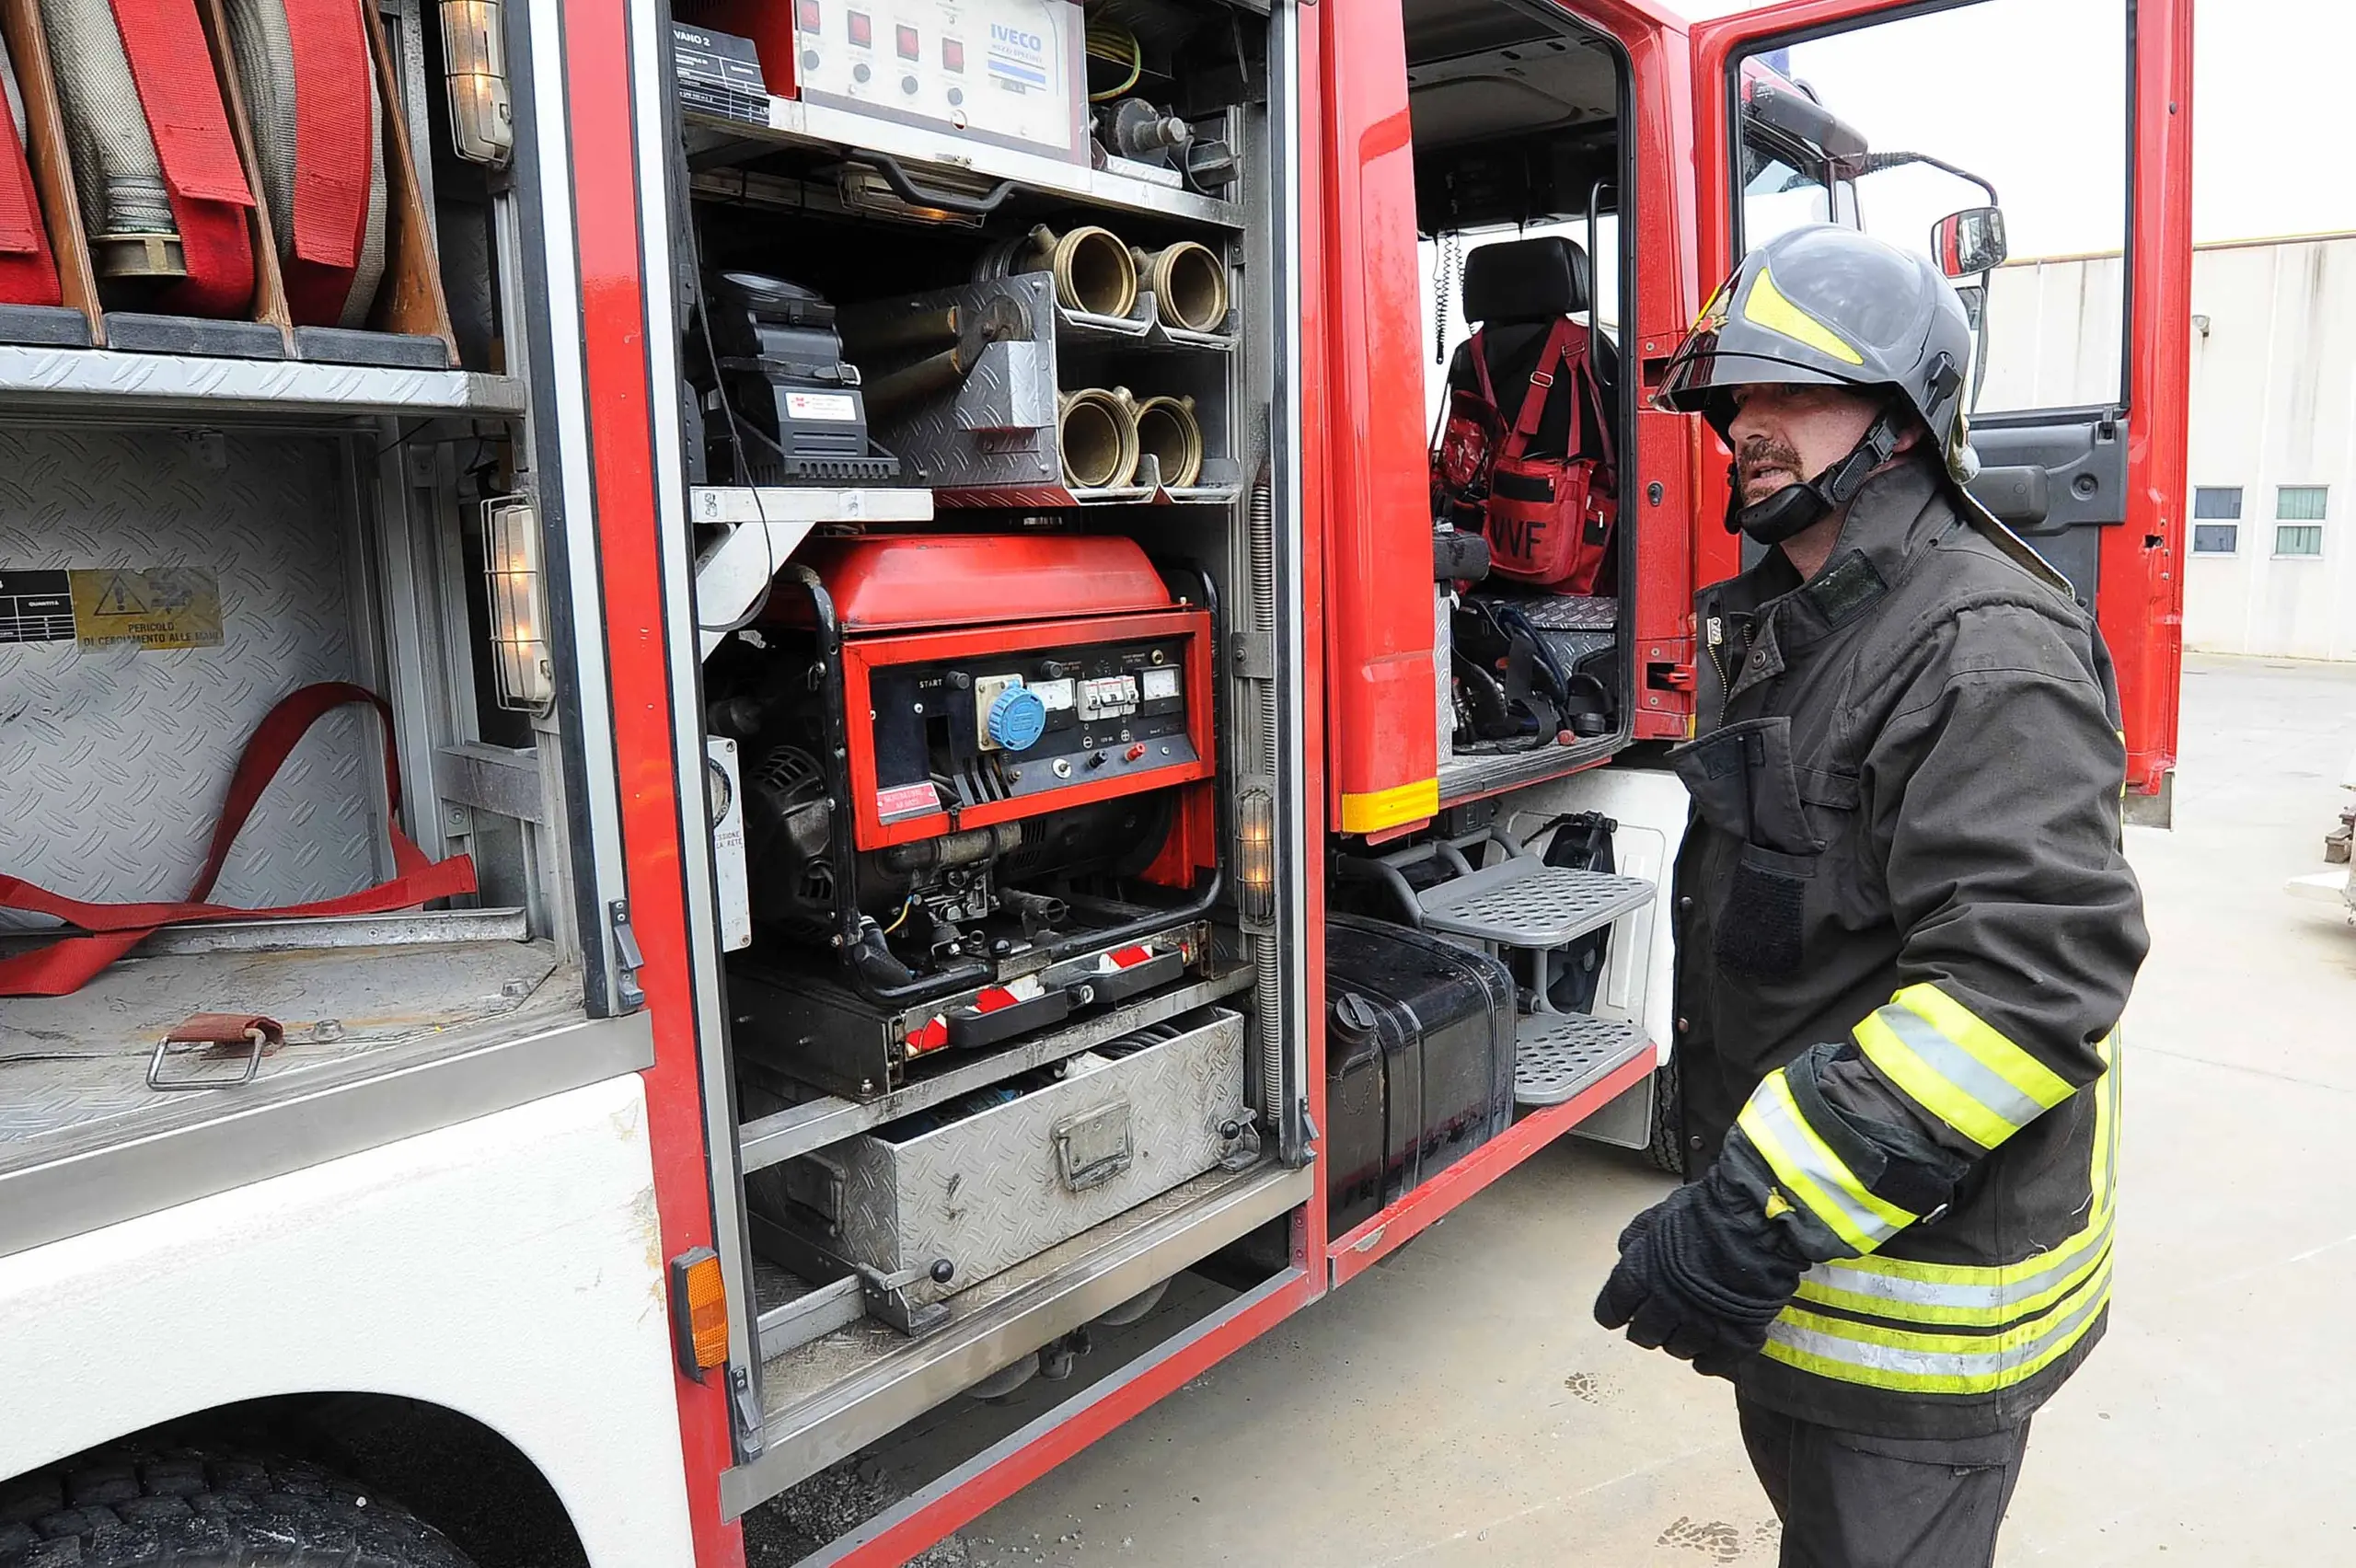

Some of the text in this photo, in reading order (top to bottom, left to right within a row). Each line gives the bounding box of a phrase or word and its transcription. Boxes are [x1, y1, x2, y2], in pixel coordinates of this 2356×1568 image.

[673, 29, 710, 47] VANO 2
[990, 22, 1042, 52] IVECO
[1490, 514, 1547, 560] VVF
[128, 622, 175, 633] PERICOLO
[84, 637, 95, 647] DI
[170, 632, 192, 642] ALLE
[918, 678, 942, 689] START
